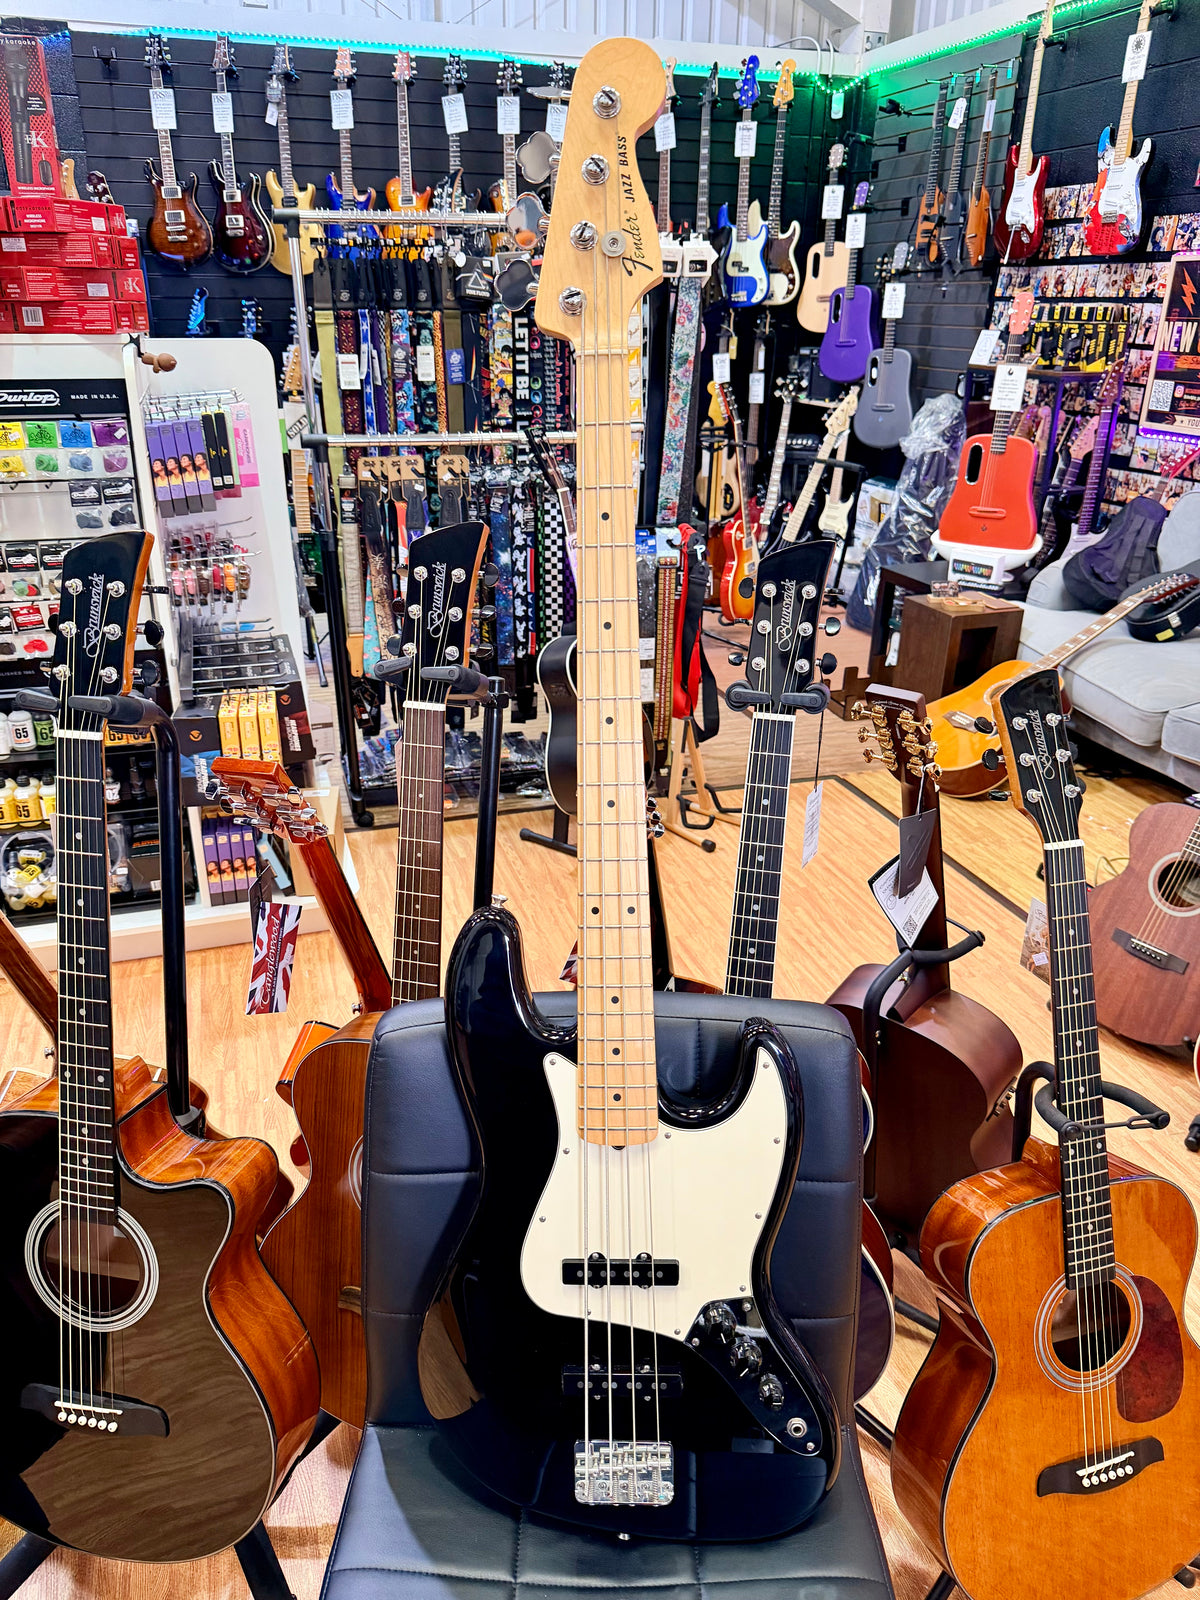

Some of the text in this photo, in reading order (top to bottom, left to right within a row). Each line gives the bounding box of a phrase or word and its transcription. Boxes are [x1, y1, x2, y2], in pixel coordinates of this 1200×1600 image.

[618, 136, 653, 276] Fender JAZZ BASS
[514, 317, 529, 352] LET
[1159, 321, 1198, 353] NEW
[515, 354, 529, 374] IT
[0, 392, 57, 403] Dunlop
[516, 376, 529, 400] BE
[82, 573, 104, 657] Brunswick
[427, 562, 447, 638] Brunswick
[774, 579, 796, 651] Brunswick
[14, 727, 28, 739] 65
[16, 805, 30, 818] 65
[261, 915, 280, 1010] Tanglewood
